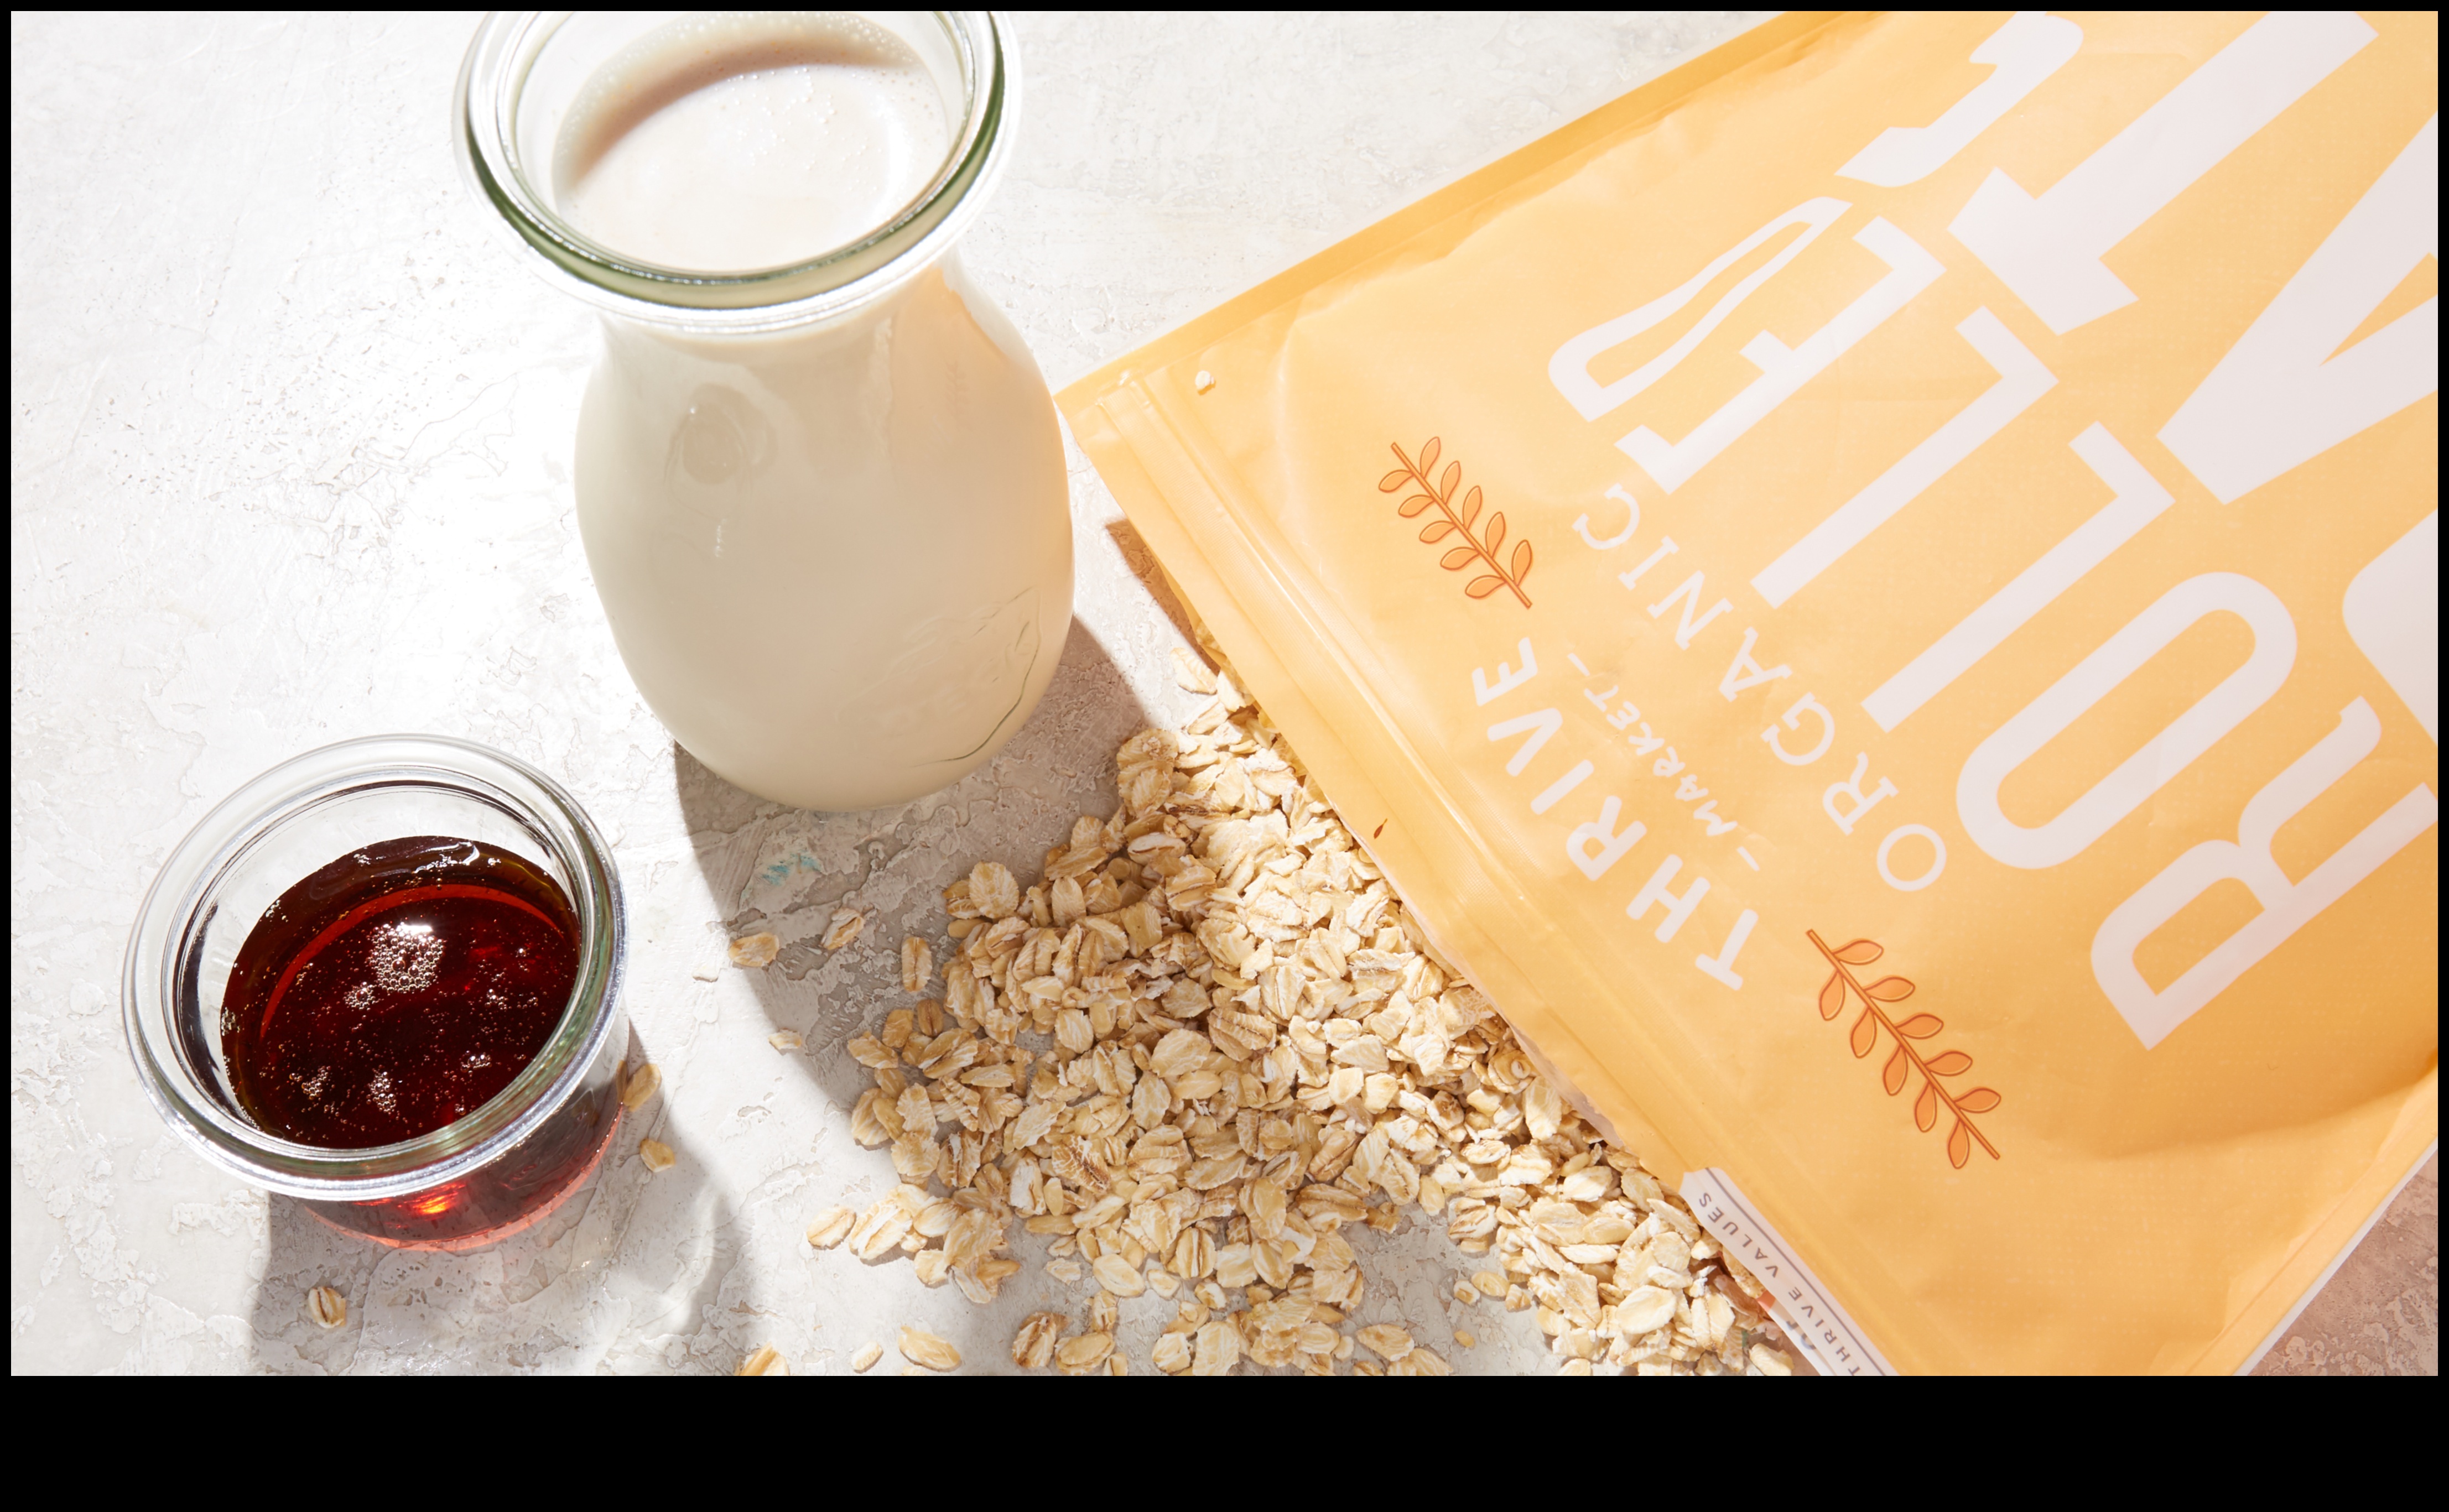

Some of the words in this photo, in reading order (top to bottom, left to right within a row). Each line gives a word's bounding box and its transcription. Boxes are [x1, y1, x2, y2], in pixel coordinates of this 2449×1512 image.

[1833, 11, 2438, 748] AT
[1548, 196, 2438, 1051] ROLLED
[1572, 483, 1947, 891] ORGANIC
[1583, 684, 1738, 837] MARKET
[1472, 637, 1759, 990] THRIVE
[1699, 1192, 1779, 1278] VALUES
[1787, 1287, 1860, 1375] THRIVE
